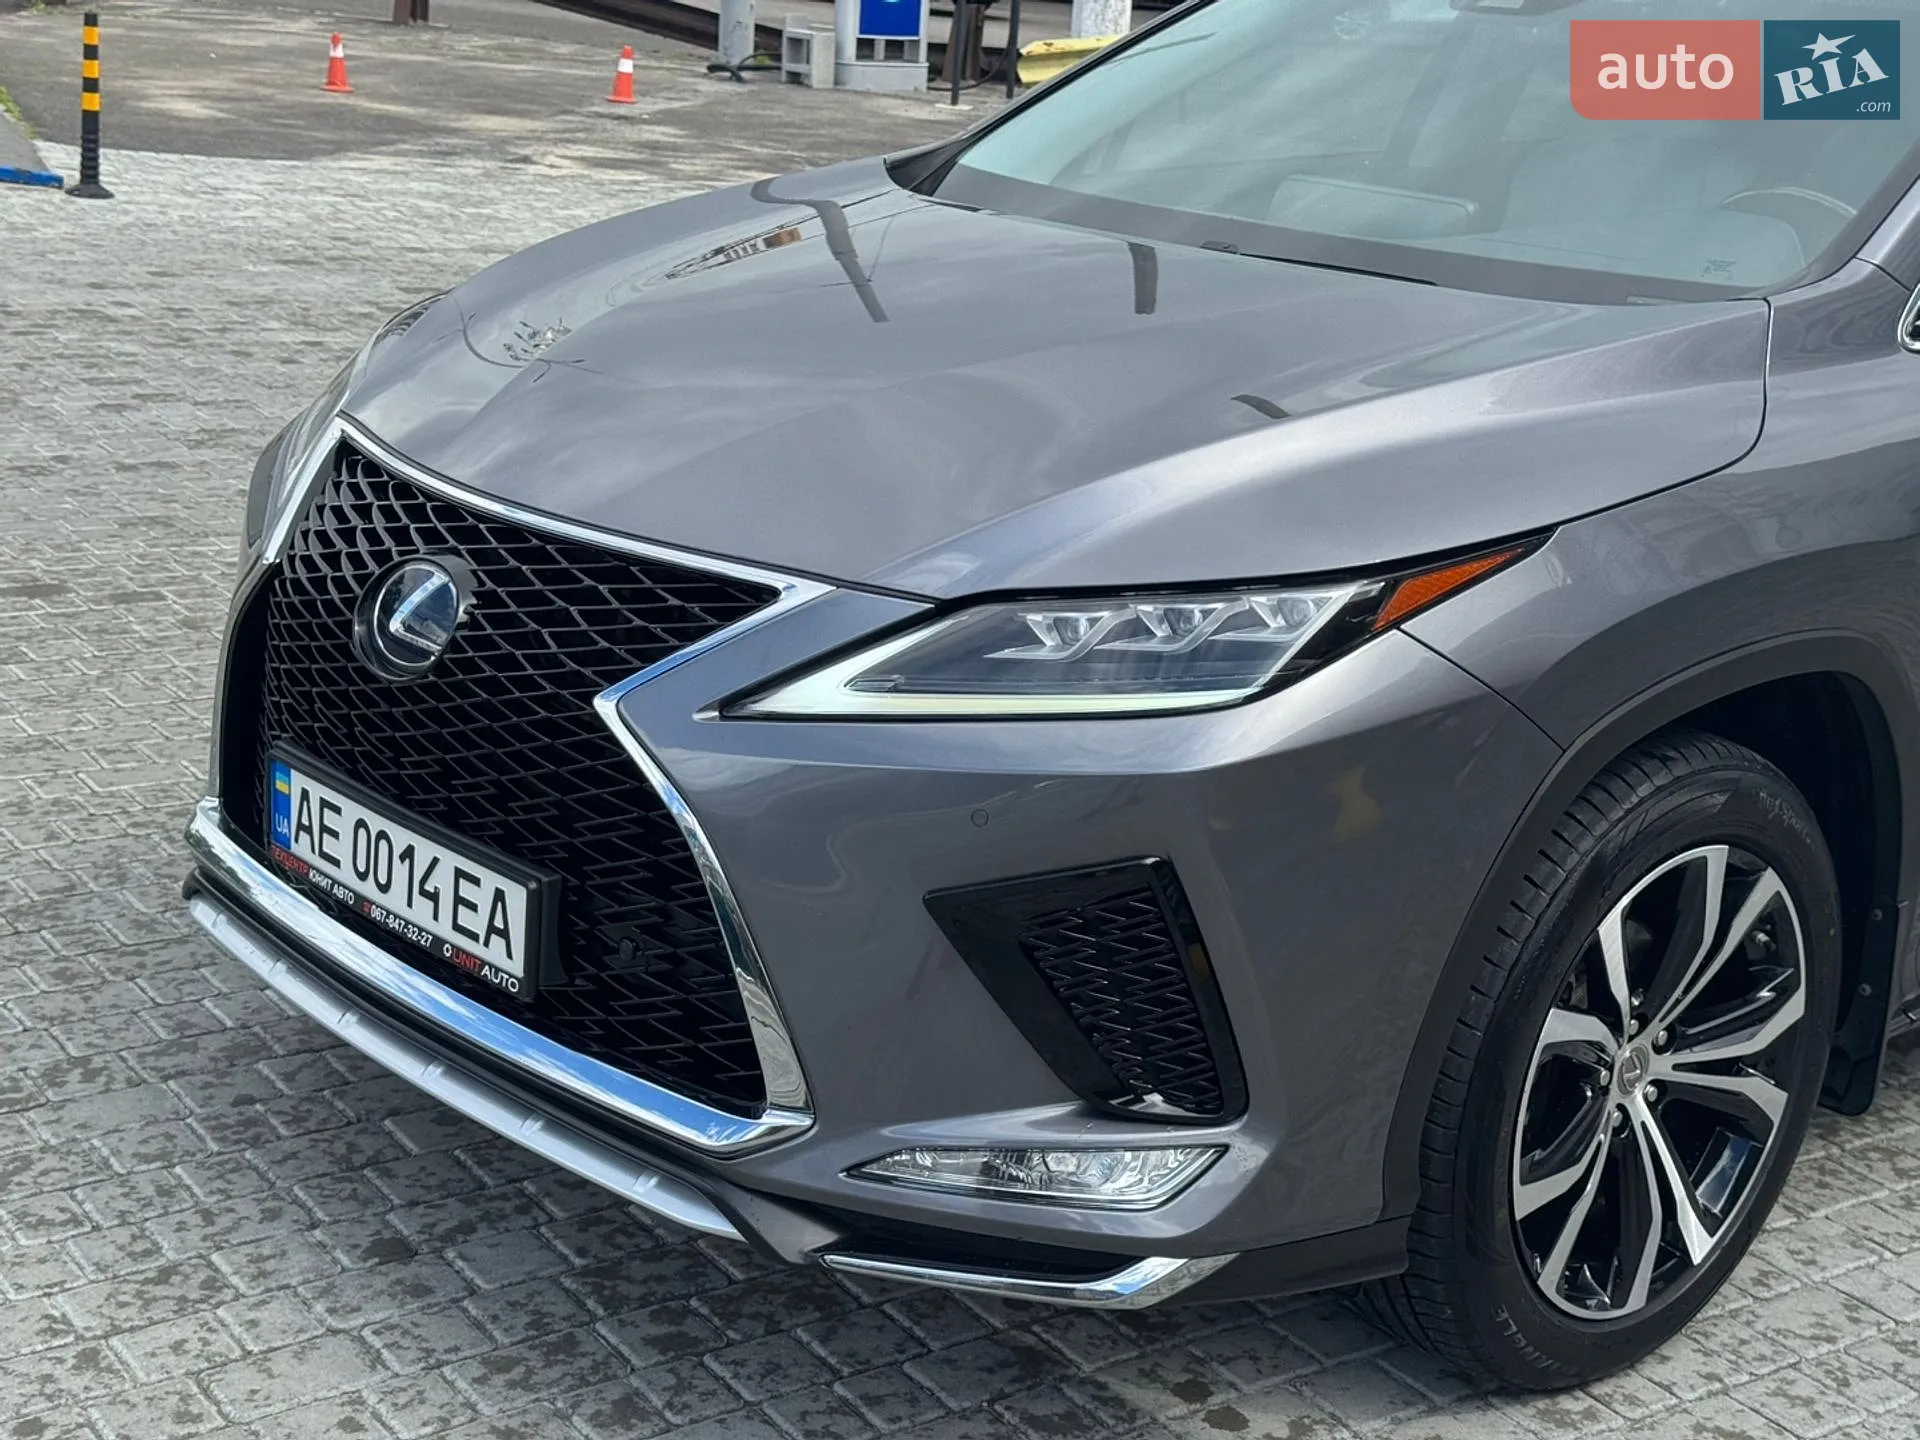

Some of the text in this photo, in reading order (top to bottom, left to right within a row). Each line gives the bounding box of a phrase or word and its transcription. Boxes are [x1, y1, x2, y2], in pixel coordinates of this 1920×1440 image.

[274, 813, 290, 839] UA
[294, 786, 514, 962] AE 0014 EA
